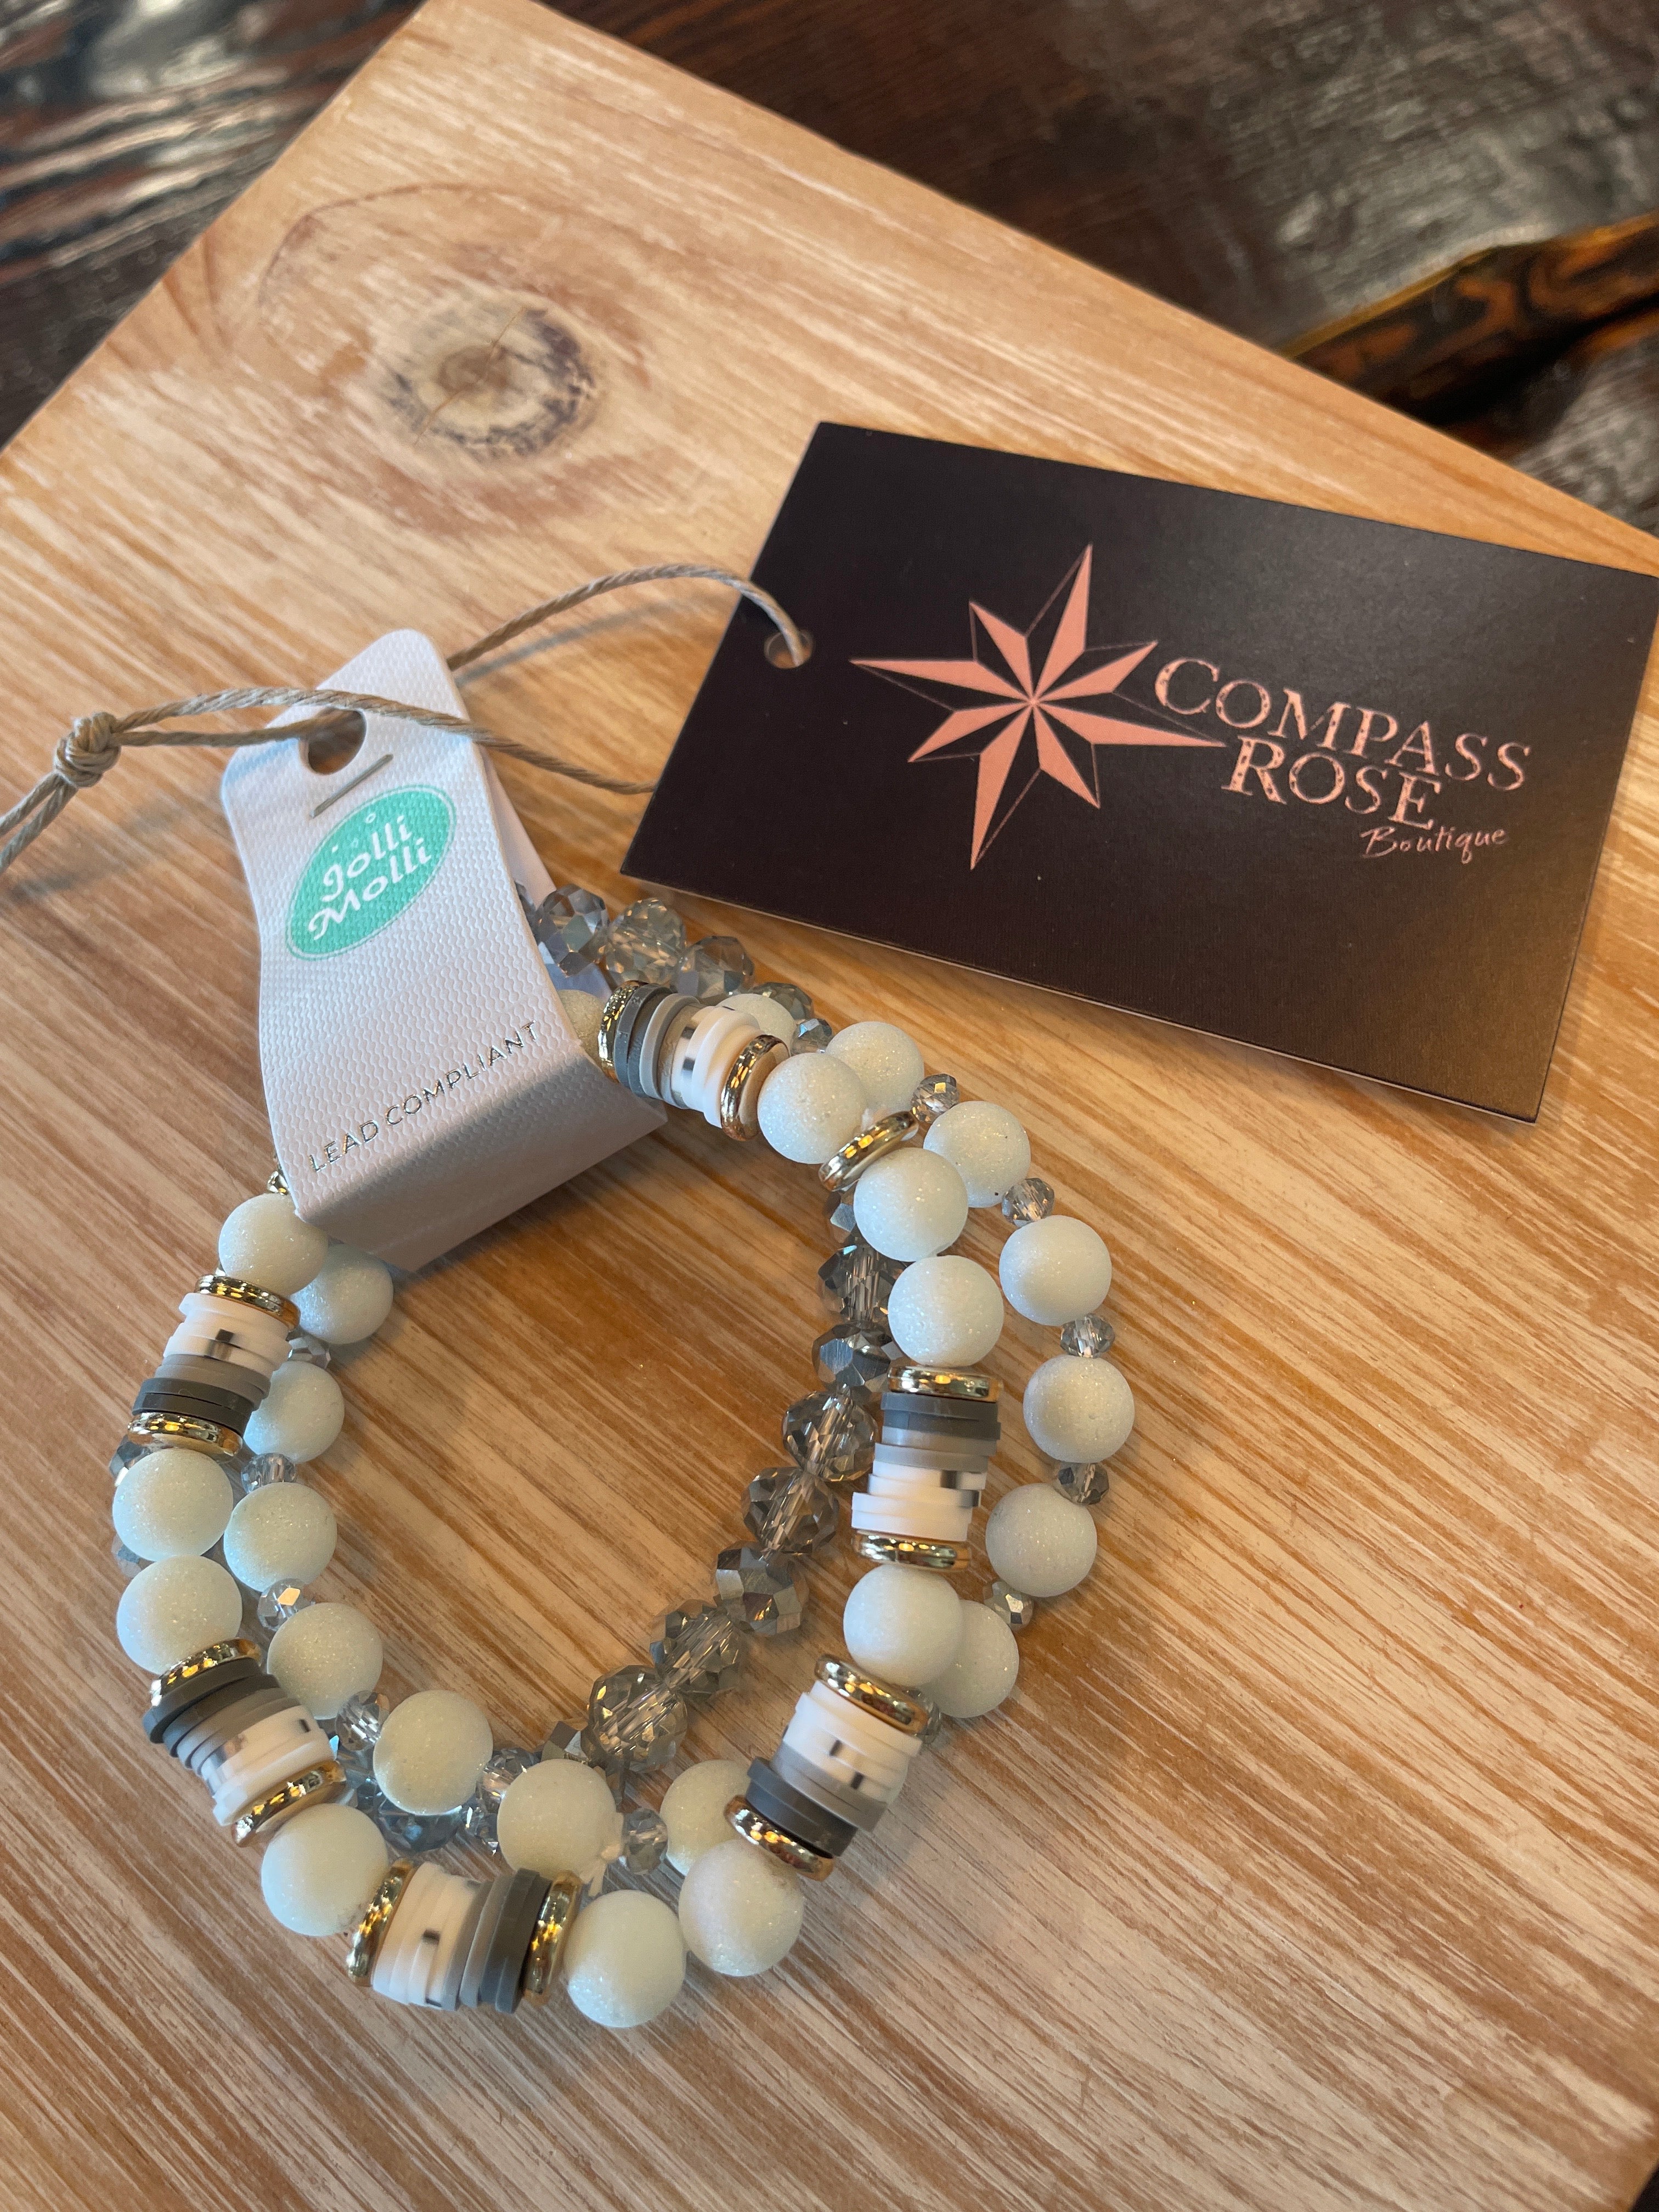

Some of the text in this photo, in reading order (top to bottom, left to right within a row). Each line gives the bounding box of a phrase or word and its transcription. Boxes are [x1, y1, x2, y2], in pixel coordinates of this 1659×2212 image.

[1154, 658, 1531, 791] COMPASS
[1221, 735, 1441, 830] ROSE
[308, 837, 432, 940] Molli
[1360, 825, 1508, 865] Boutique
[308, 1019, 538, 1172] LEAD COMPLIANT
